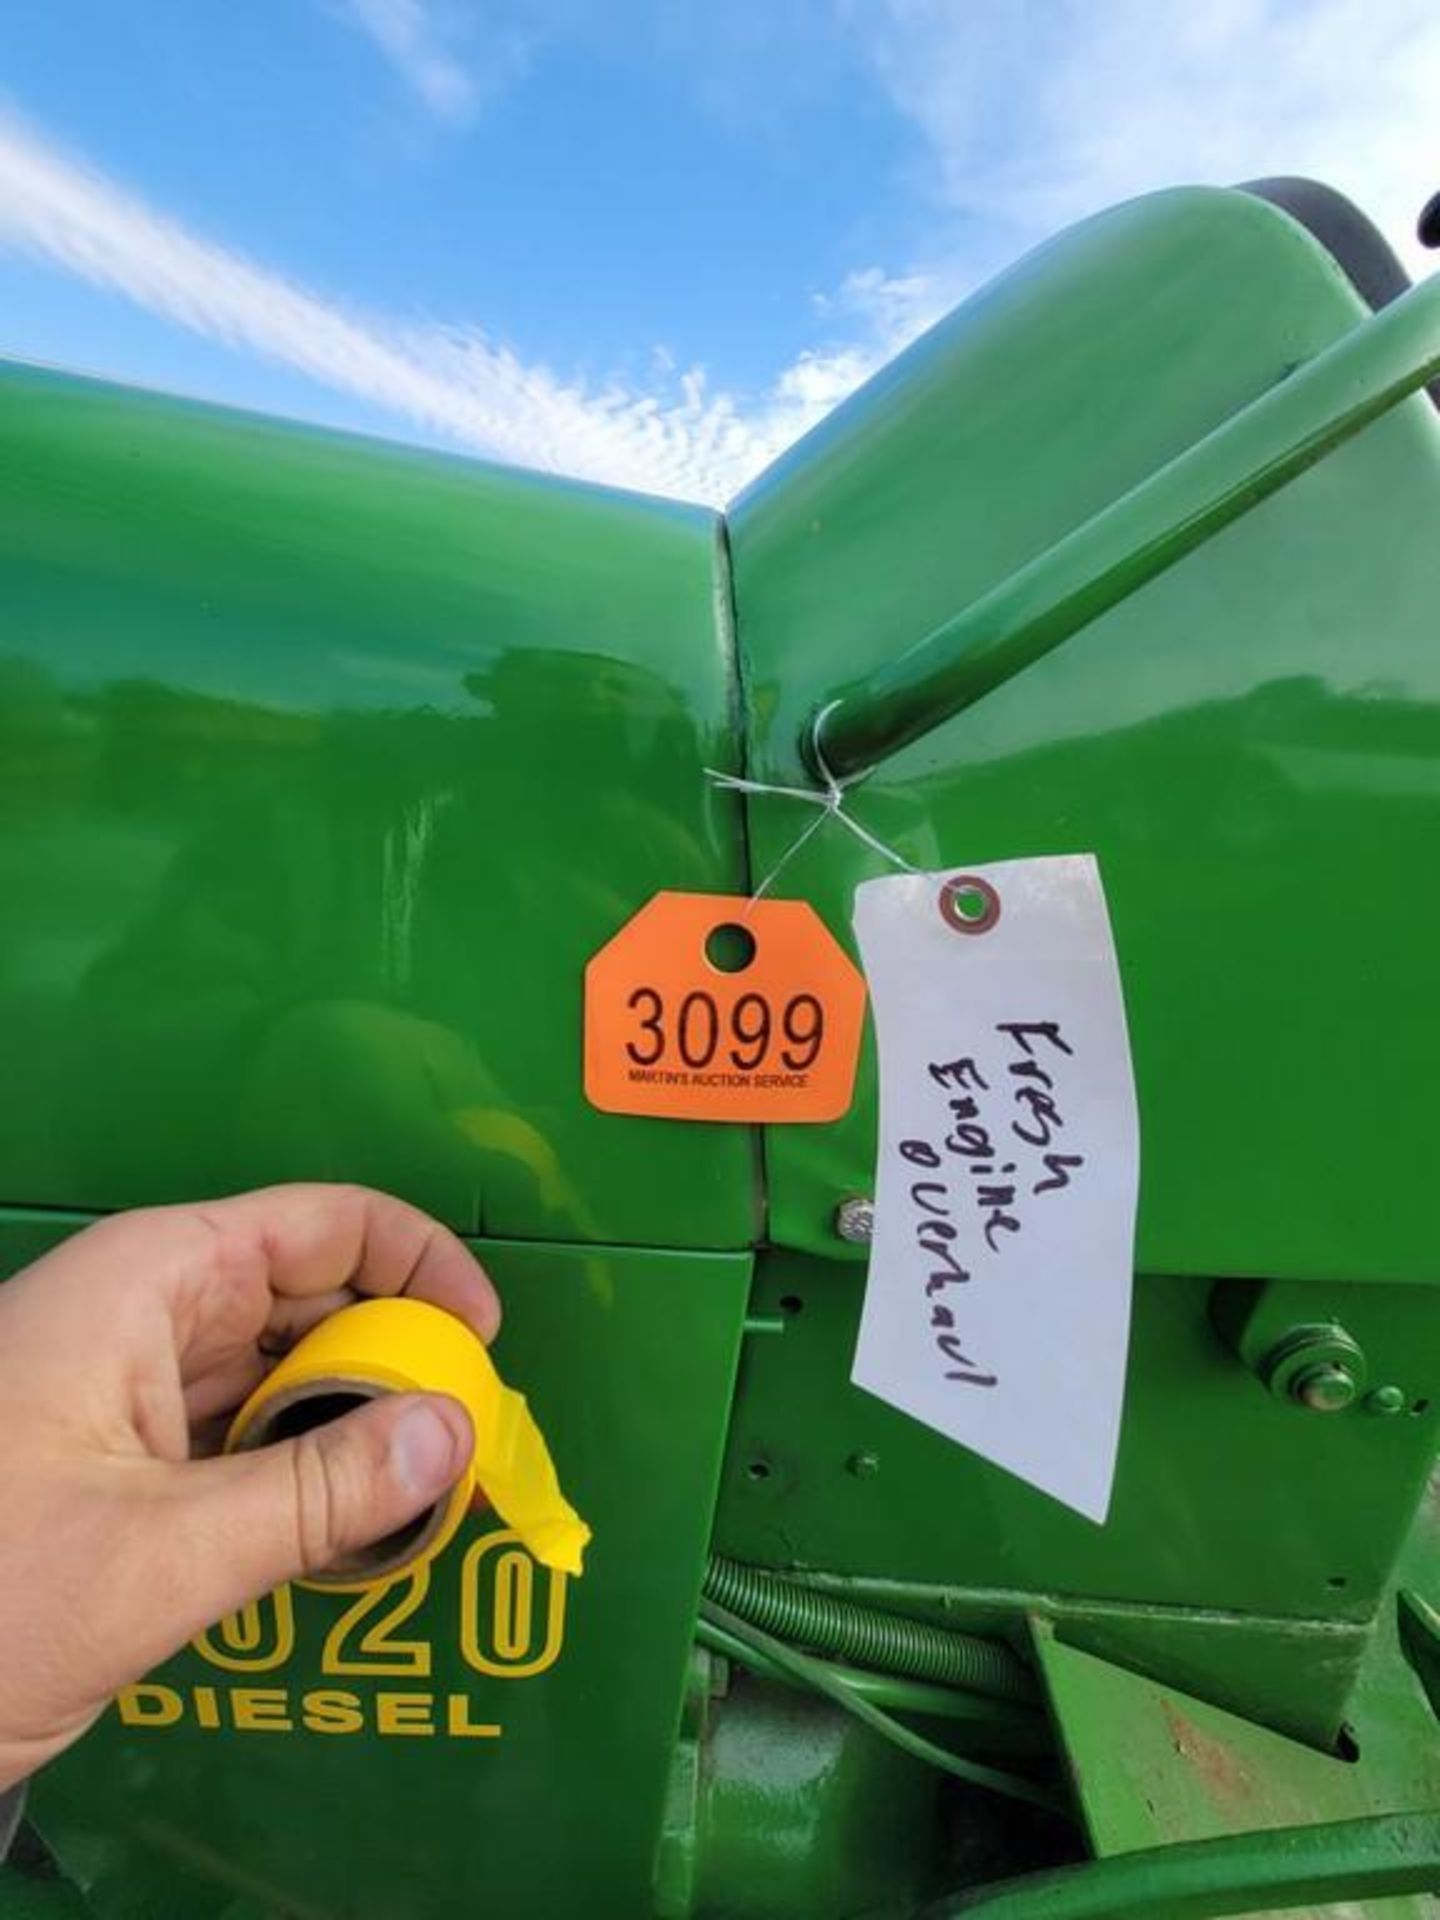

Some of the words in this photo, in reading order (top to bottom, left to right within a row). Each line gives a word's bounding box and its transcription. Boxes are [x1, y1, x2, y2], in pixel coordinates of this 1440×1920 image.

[625, 986, 824, 1072] 3099
[628, 1070, 688, 1086] MARTIN'S
[692, 1072, 751, 1088] AUCTION
[754, 1074, 809, 1089] SERVICE
[996, 1021, 1084, 1195] Fresh
[928, 1058, 1021, 1253] Engine
[117, 1683, 502, 1737] DIESEL
